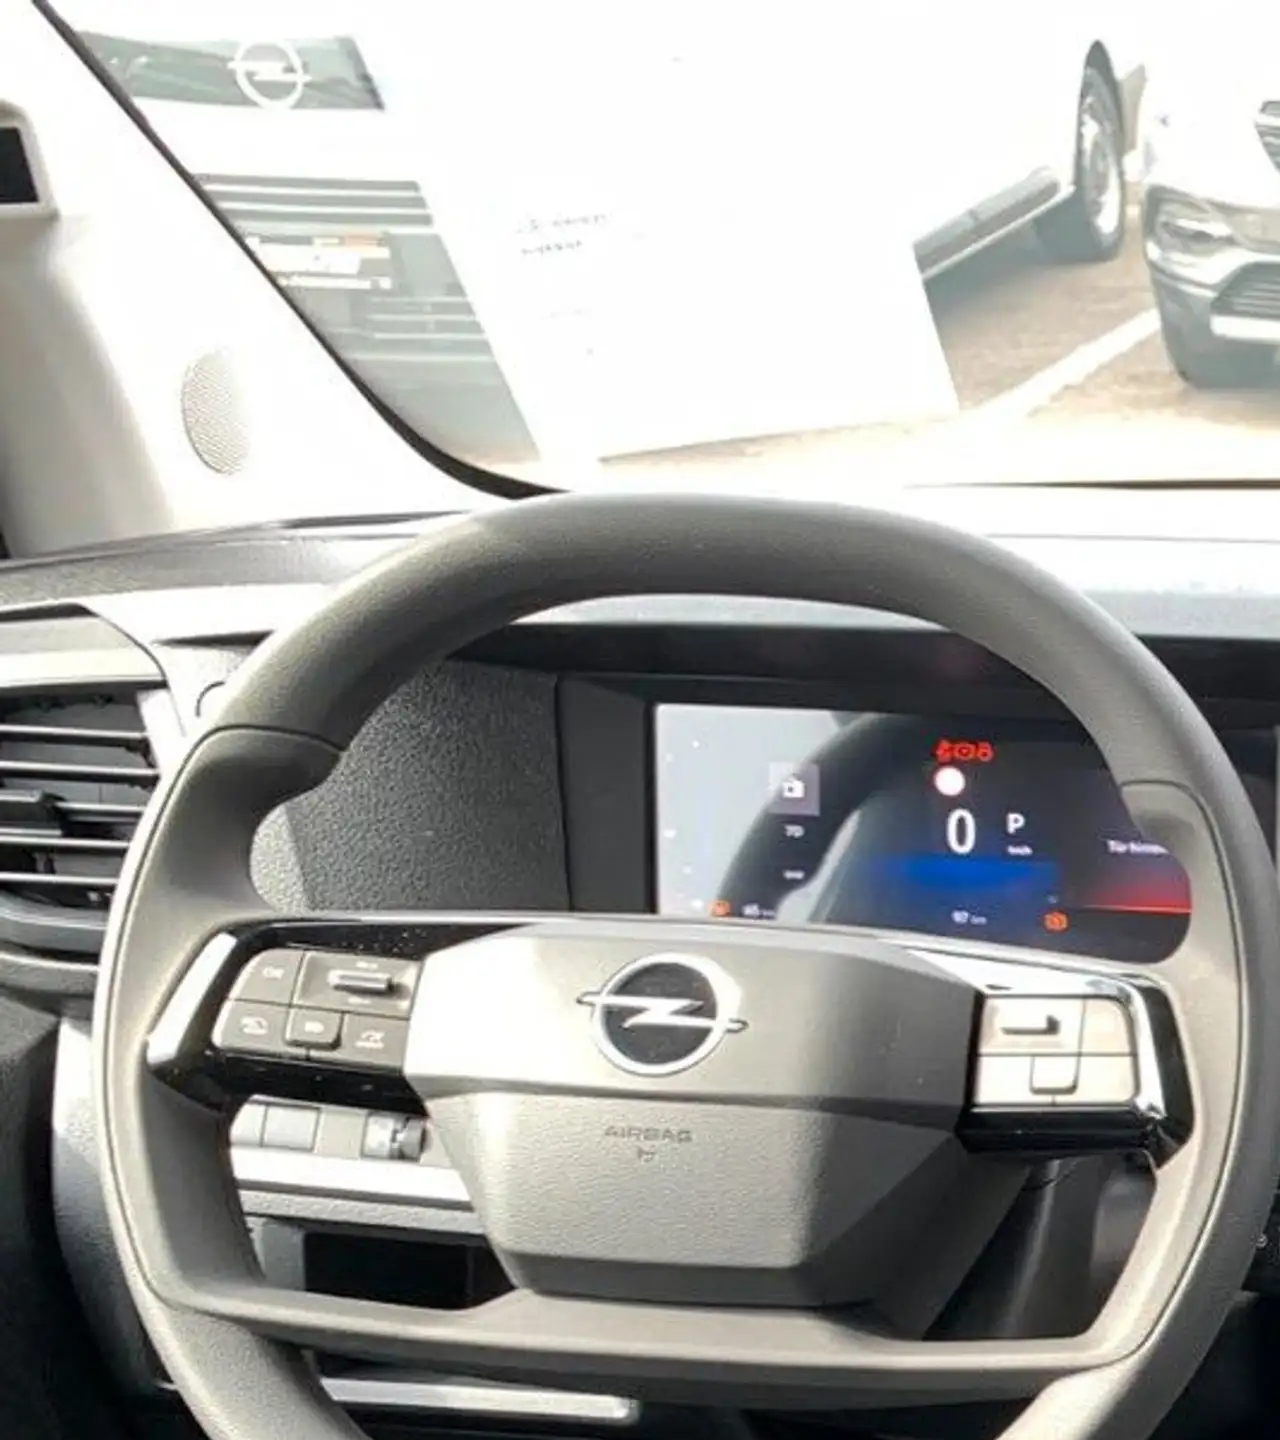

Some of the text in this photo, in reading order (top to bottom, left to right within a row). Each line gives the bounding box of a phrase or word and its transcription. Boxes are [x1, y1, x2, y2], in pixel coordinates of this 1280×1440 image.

[946, 807, 1025, 855] 0 P
[604, 1124, 693, 1144] AIRBAG
